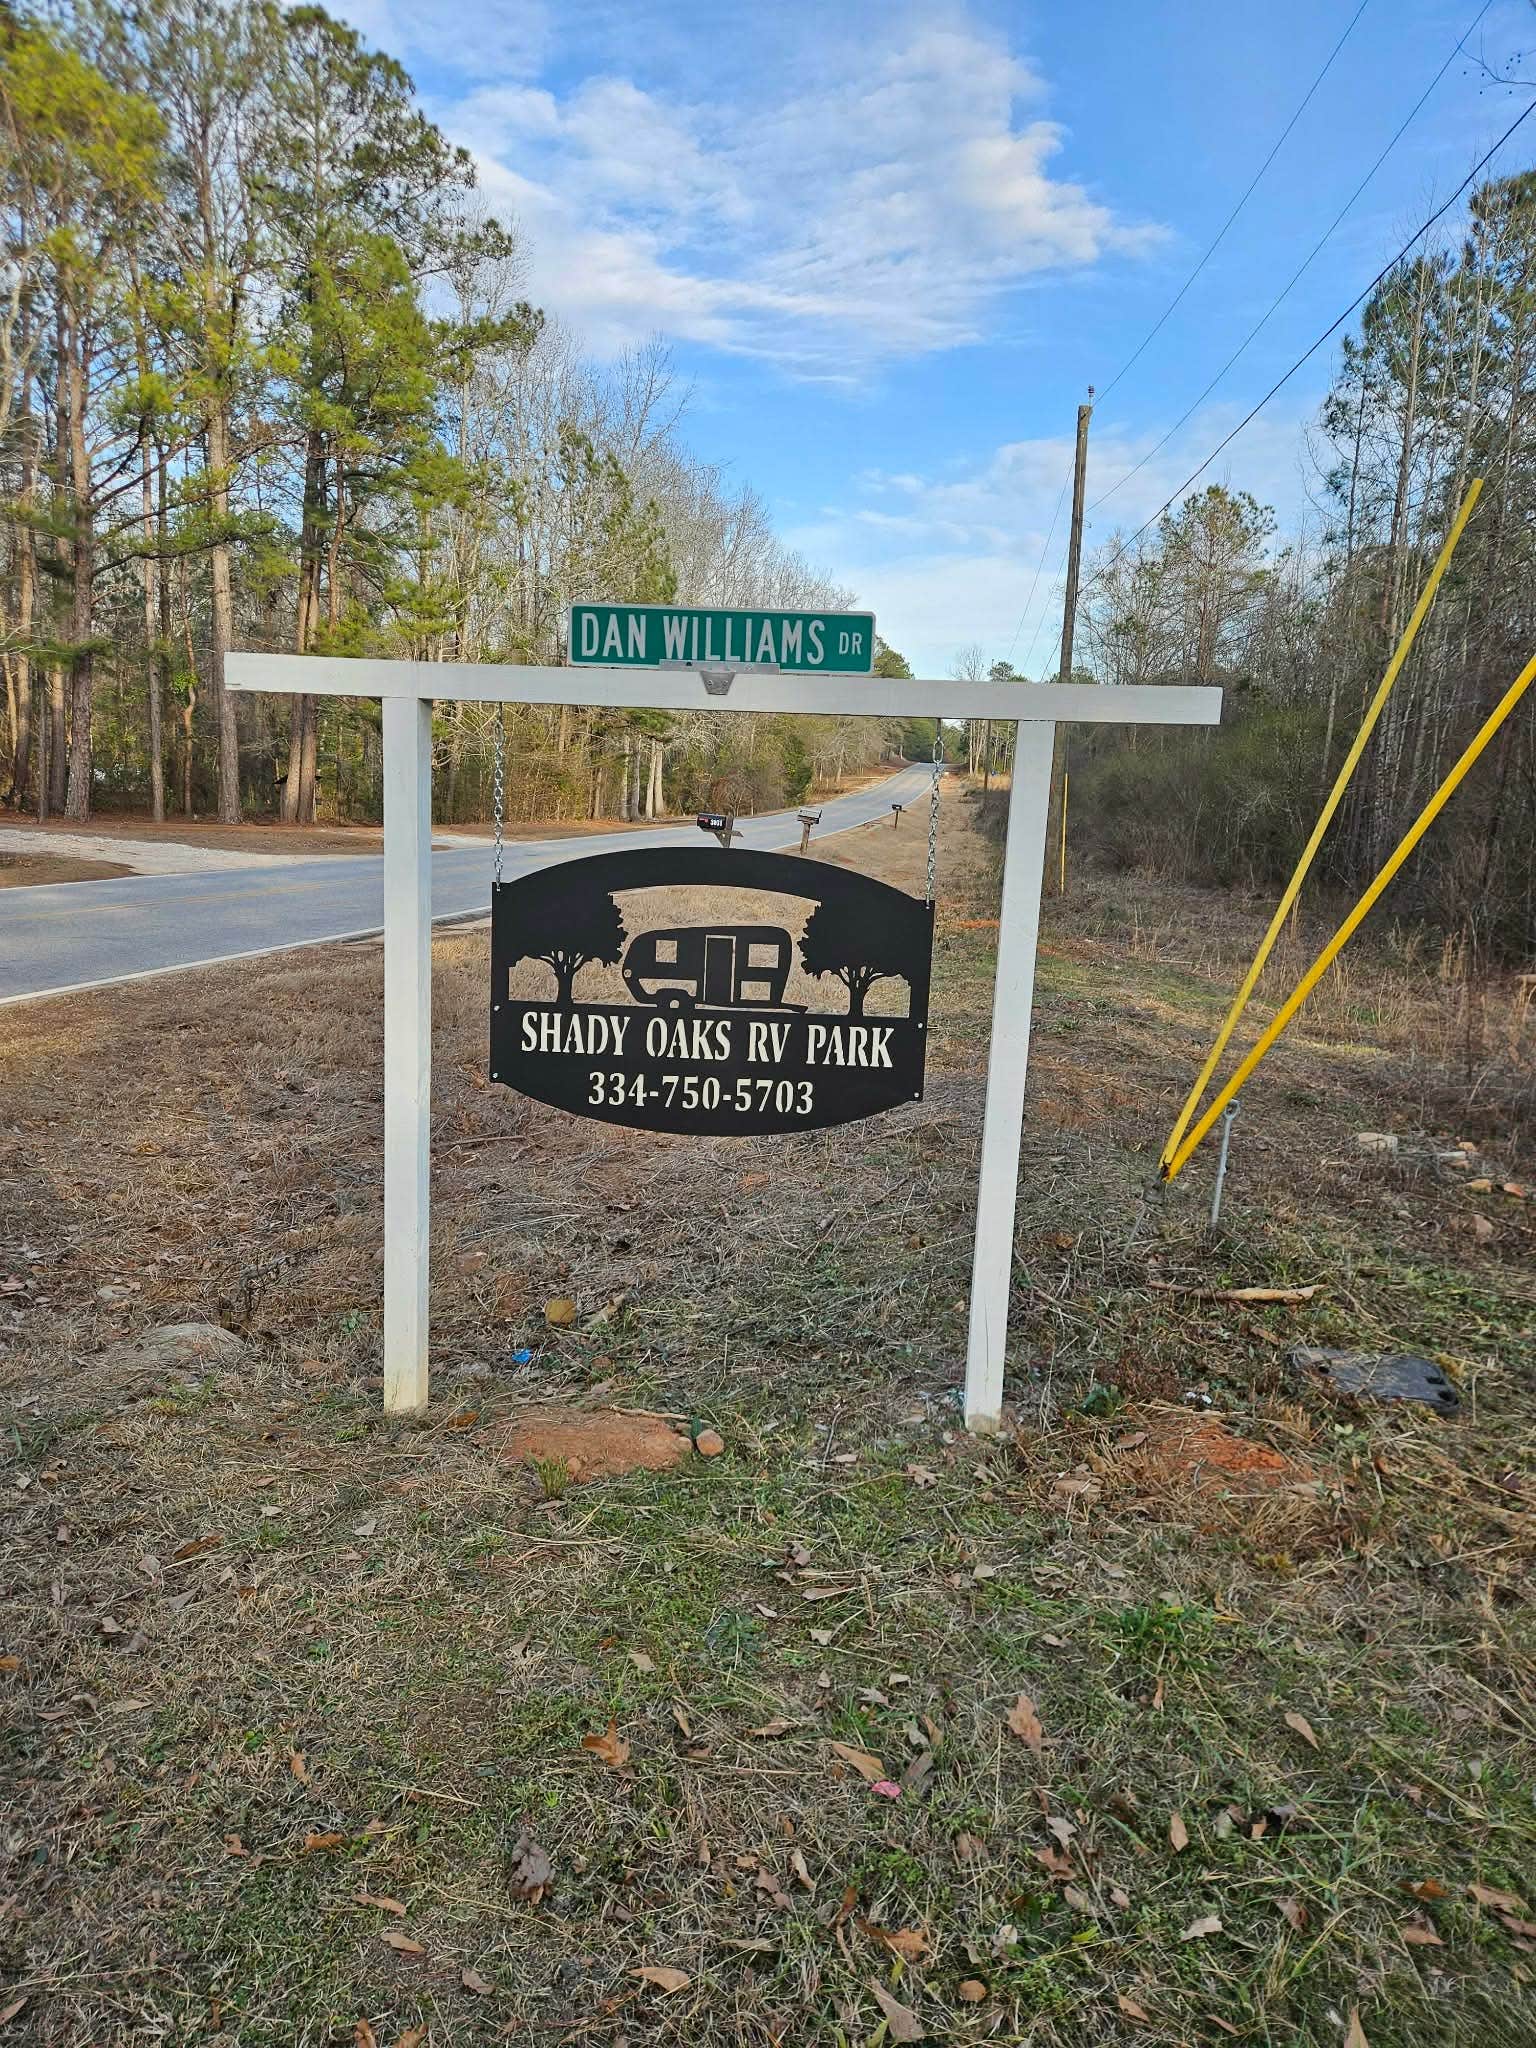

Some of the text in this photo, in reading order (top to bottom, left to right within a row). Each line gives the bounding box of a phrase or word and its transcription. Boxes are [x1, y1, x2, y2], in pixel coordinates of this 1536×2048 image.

[581, 612, 863, 665] DAN WILLIAMS DR
[521, 1011, 895, 1069] SHADY OAKS RV PARK
[588, 1071, 814, 1115] 334-750-5703
